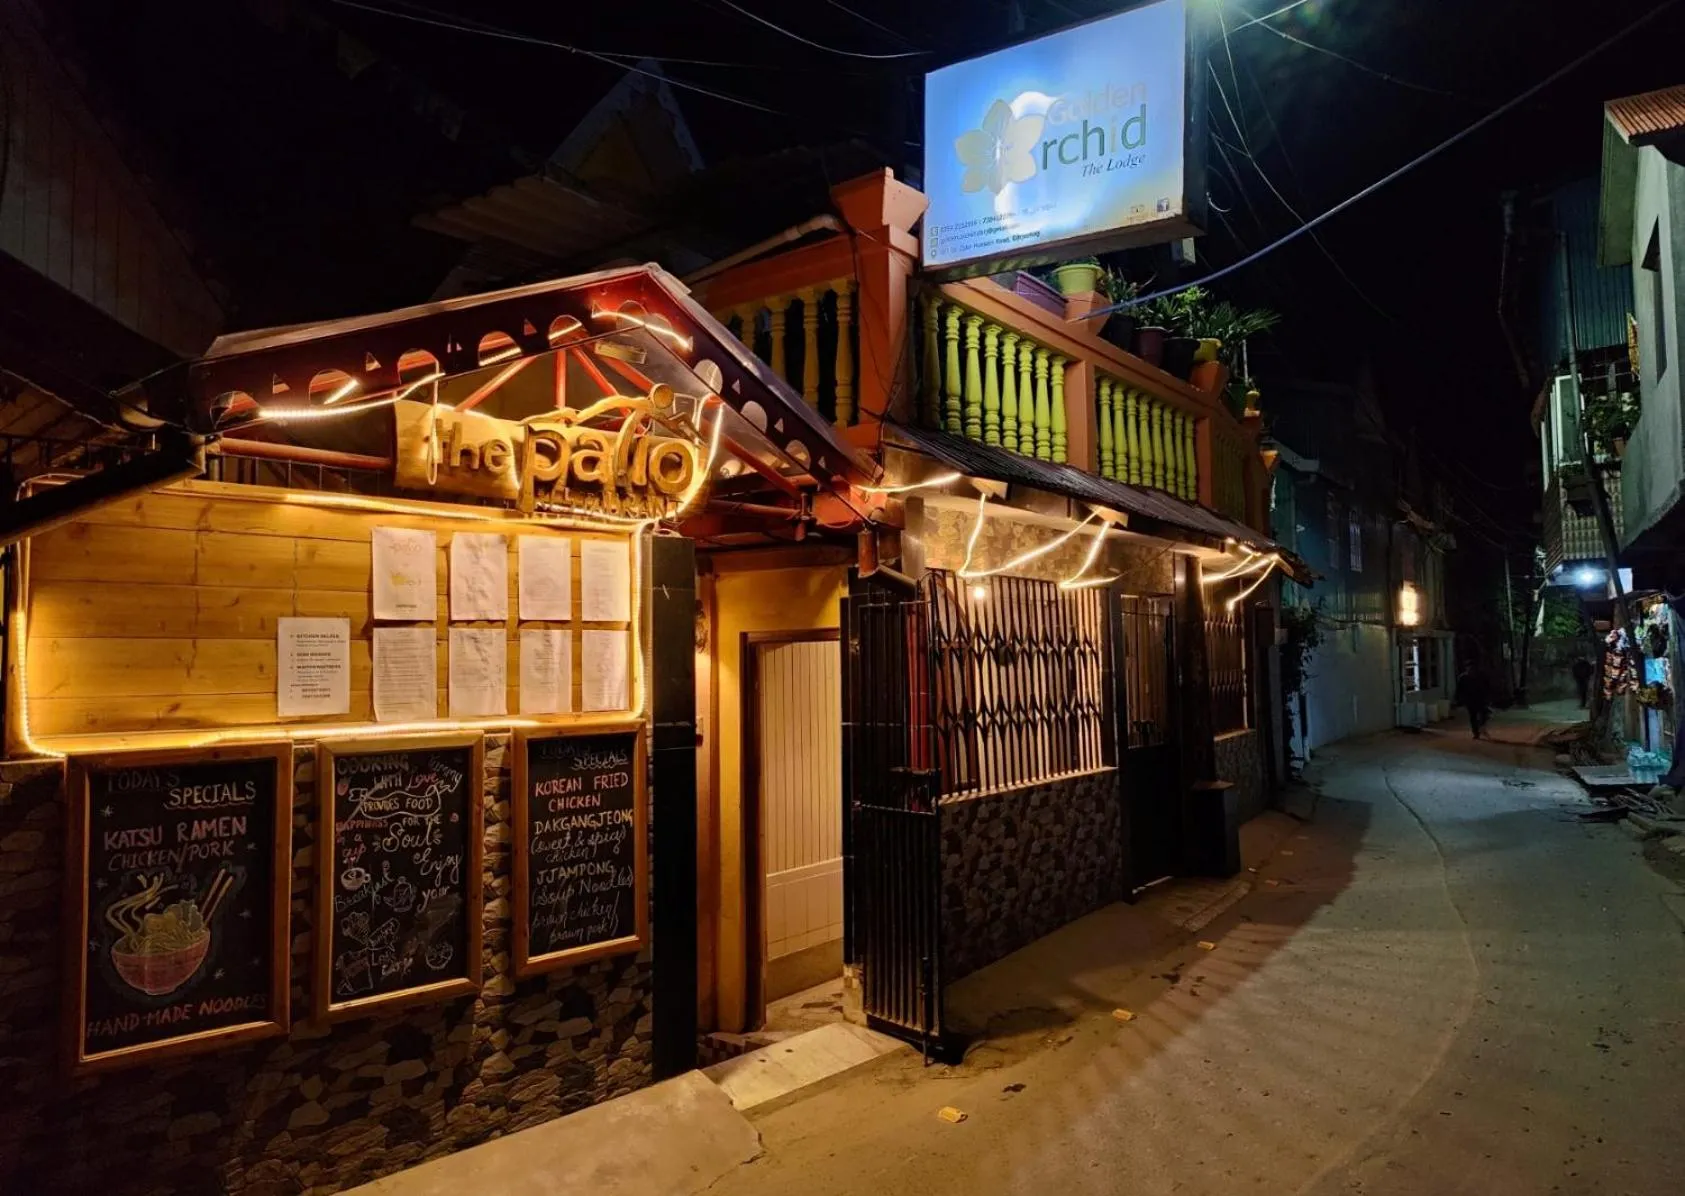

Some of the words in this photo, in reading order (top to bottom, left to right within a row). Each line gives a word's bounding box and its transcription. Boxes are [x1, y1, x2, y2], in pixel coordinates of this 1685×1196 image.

[1082, 162, 1104, 177] The
[1106, 153, 1146, 172] Lodge
[432, 416, 513, 474] the
[519, 408, 696, 514] palio
[337, 756, 410, 775] COOKING
[168, 780, 257, 808] SPECIALS
[535, 776, 582, 797] KOREAN
[593, 771, 629, 790] FRIED
[363, 798, 400, 813] PROVIDES
[405, 797, 433, 811] FOOD
[548, 792, 601, 812] CHICKEN
[104, 821, 163, 852] KATSU
[177, 815, 248, 843] RAMEN
[402, 817, 421, 827] FOR
[534, 808, 634, 834] DAKGANGJEONG
[382, 821, 434, 853] Soul
[574, 830, 585, 847] &
[537, 860, 613, 886] JJAMPONG
[416, 885, 451, 914] your
